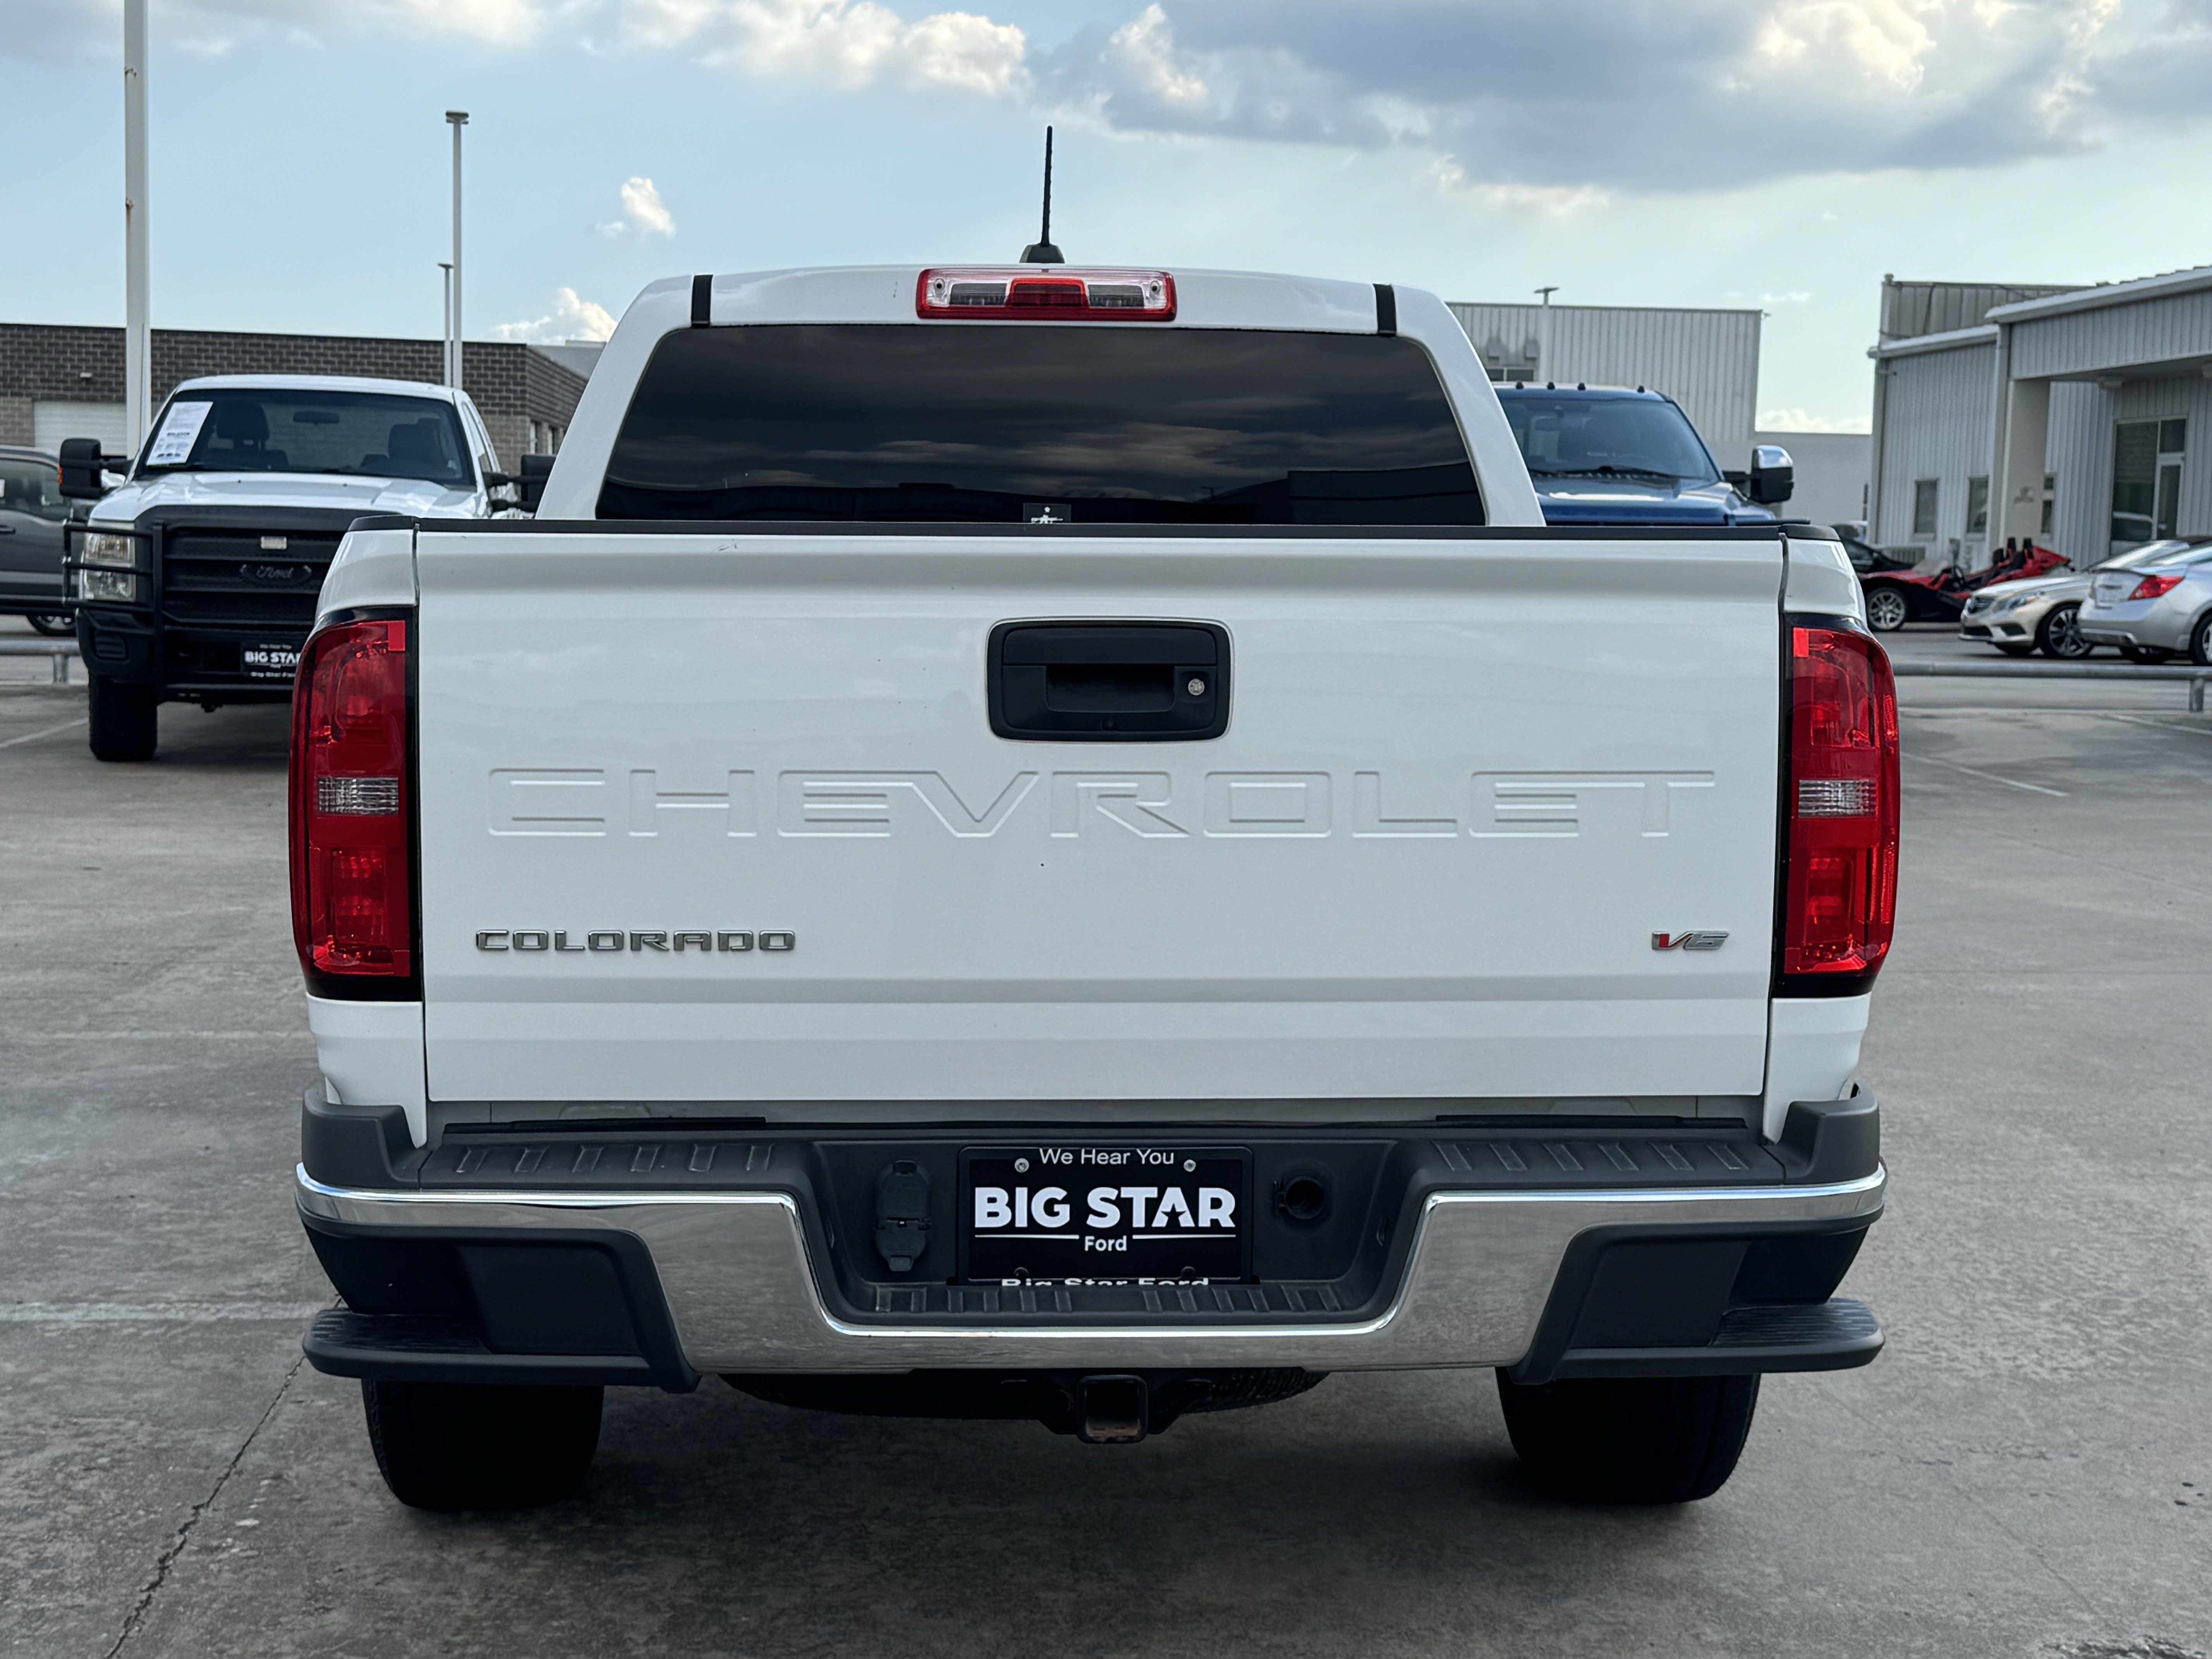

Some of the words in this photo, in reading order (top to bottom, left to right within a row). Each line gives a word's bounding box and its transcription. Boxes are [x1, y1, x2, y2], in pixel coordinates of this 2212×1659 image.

[245, 651, 268, 663] BIG
[488, 768, 1715, 838] CHEVROLET
[476, 930, 795, 951] COLORADO
[1652, 930, 1729, 950] V6
[1039, 1148, 1073, 1164] We
[1081, 1148, 1131, 1164] Hear
[1136, 1148, 1174, 1164] You
[975, 1187, 1070, 1228] BIG
[1086, 1187, 1236, 1228] STAR
[1085, 1235, 1127, 1251] Ford
